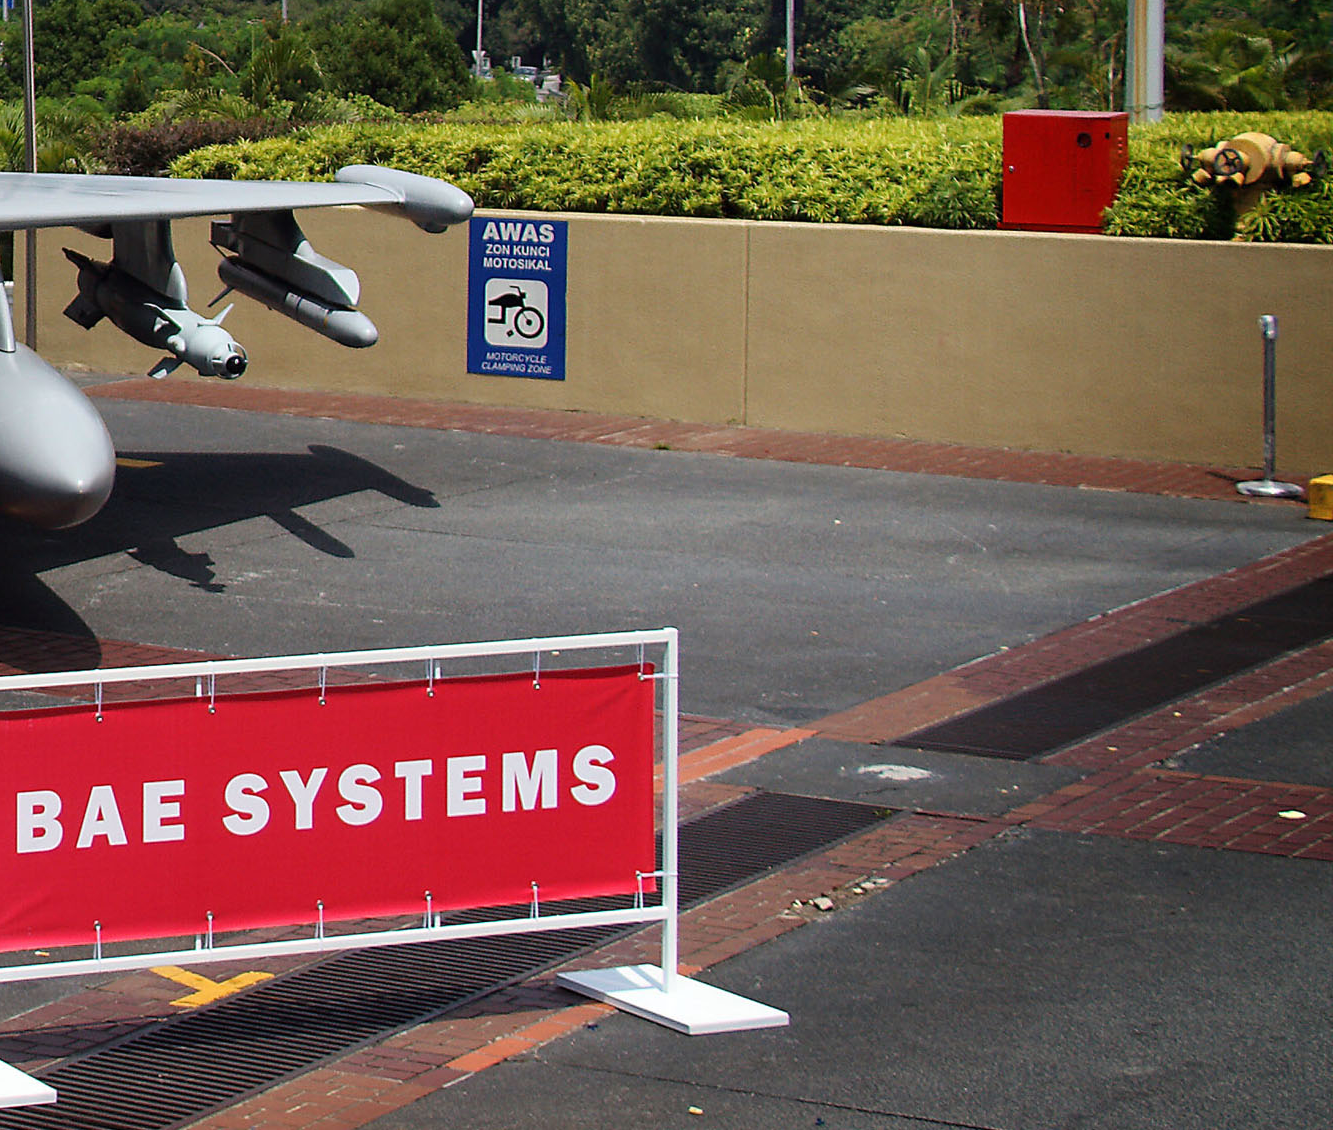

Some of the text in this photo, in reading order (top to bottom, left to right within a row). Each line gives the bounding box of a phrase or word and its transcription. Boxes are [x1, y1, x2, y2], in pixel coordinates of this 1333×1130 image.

[482, 221, 555, 243] AWAS
[485, 243, 550, 258] ZON KUNCI
[483, 256, 552, 271] MOTOSIKAL
[486, 351, 548, 364] MOTORCYCLE
[481, 360, 553, 375] CLAMPING ZONE
[16, 744, 616, 854] BAE SYSTEMS
